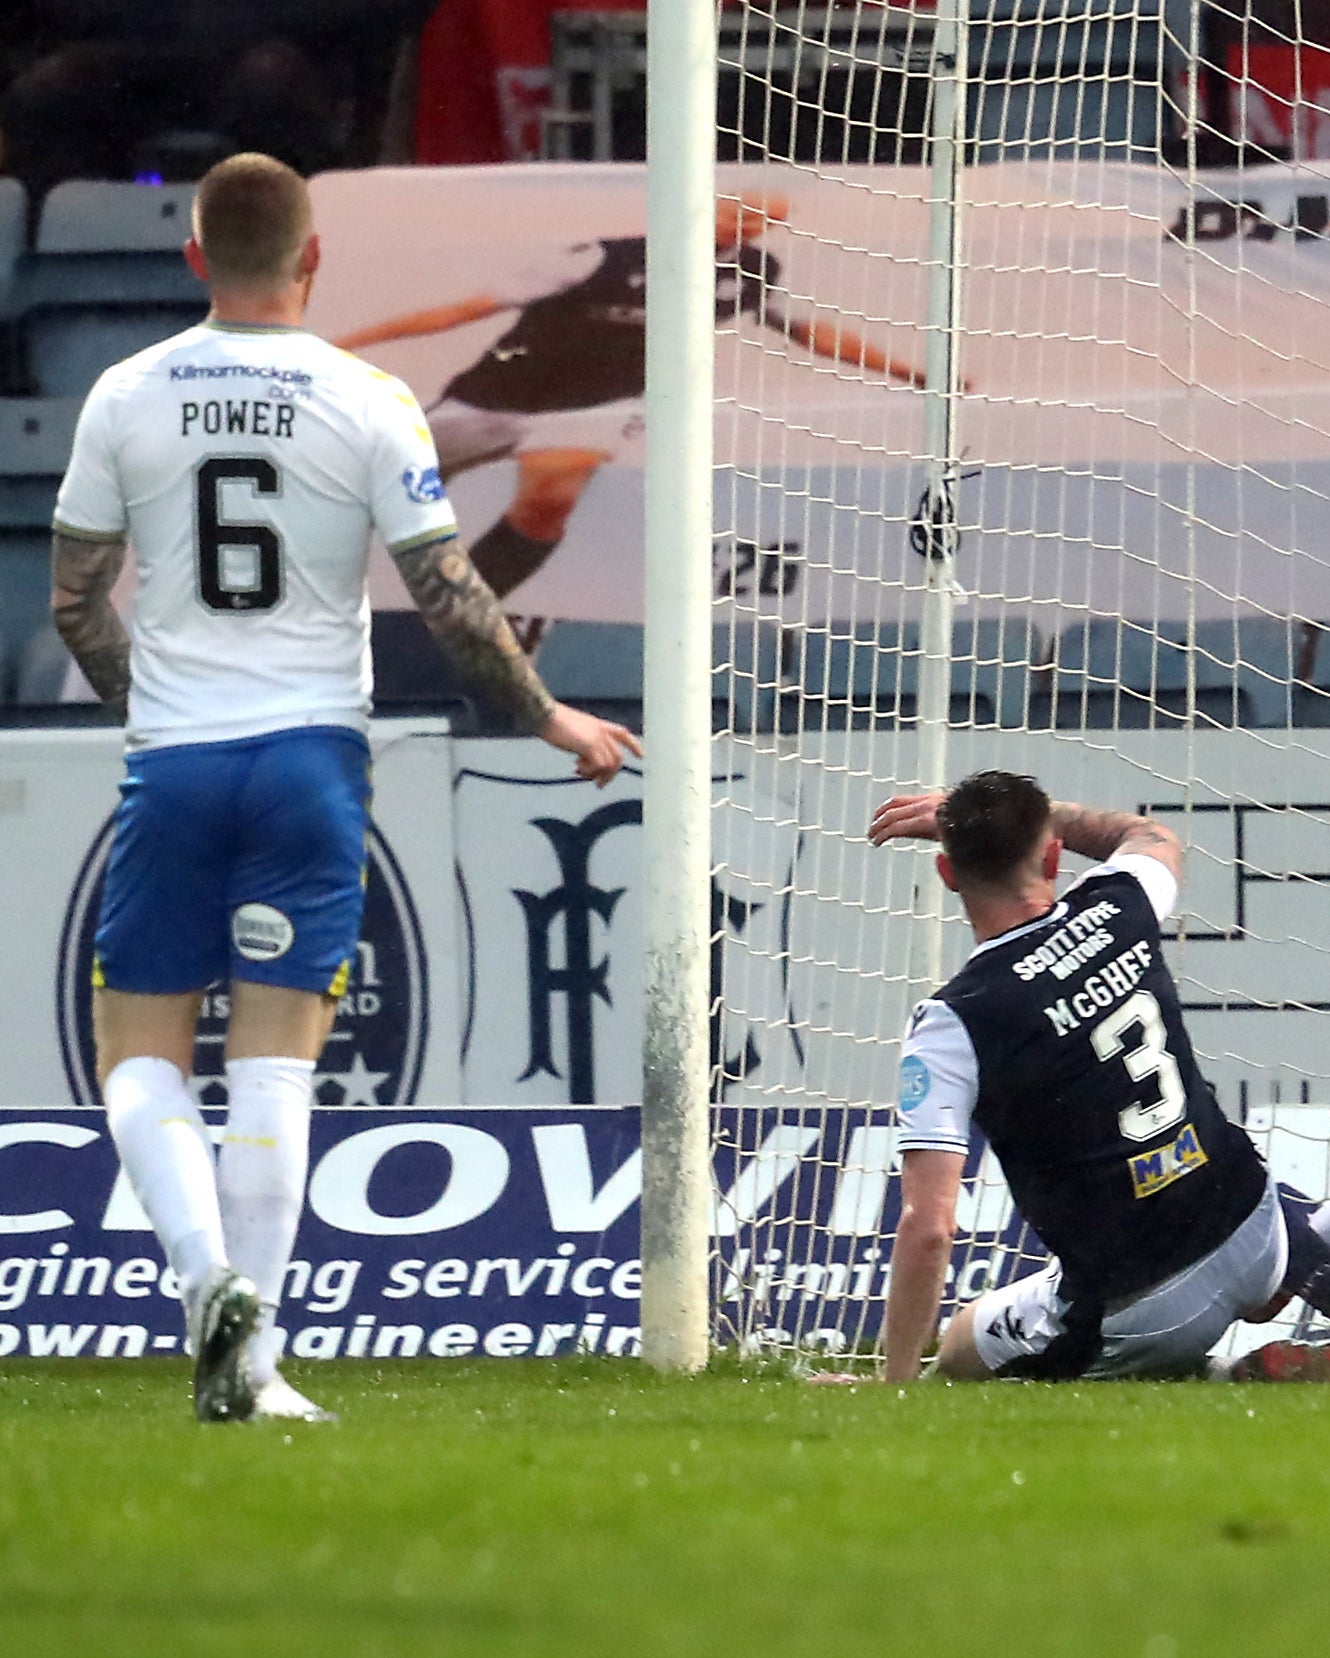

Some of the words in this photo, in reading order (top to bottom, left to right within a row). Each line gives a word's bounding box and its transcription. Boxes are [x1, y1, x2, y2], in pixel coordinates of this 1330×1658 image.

[181, 400, 295, 438] POWER
[196, 453, 286, 615] 6
[1012, 927, 1077, 982] SCOTT
[1090, 988, 1188, 1143] 3
[0, 1123, 1016, 1235] COWN
[382, 1243, 642, 1299] service
